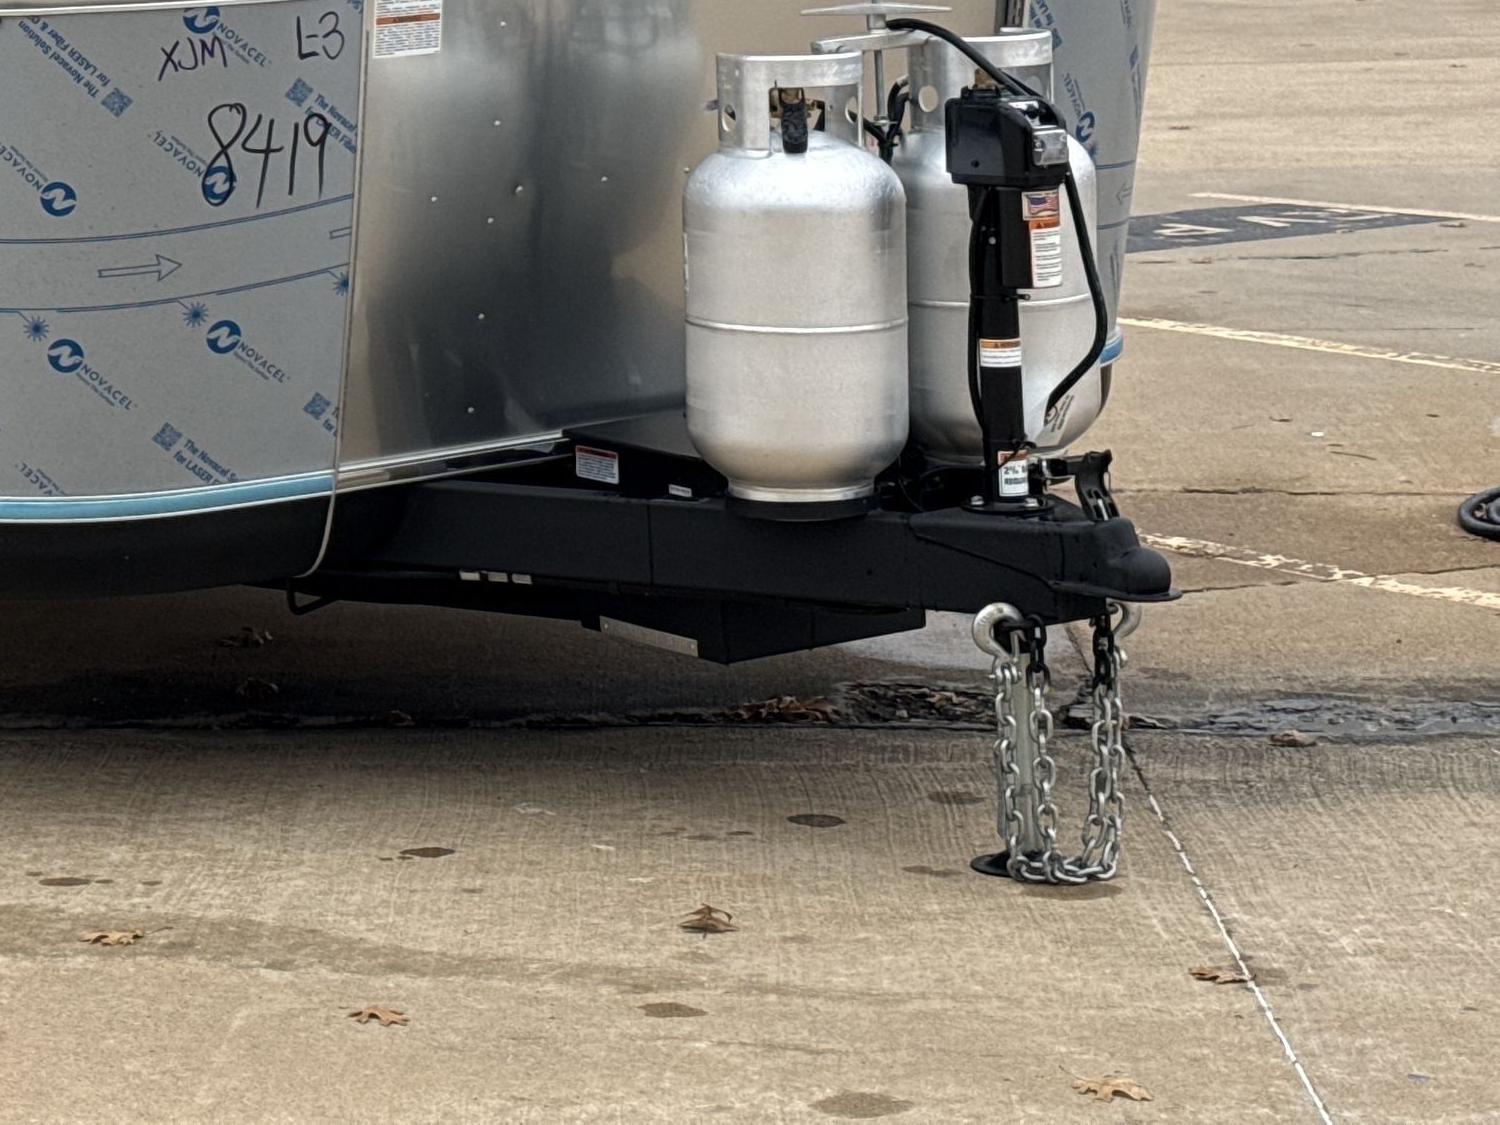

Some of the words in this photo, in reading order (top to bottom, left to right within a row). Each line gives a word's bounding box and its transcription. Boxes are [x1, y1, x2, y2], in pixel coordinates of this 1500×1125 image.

[18, 20, 51, 54] Solution
[47, 29, 70, 51] Fiber
[217, 22, 266, 67] NOVACEL
[49, 51, 83, 83] Novacel
[67, 47, 97, 75] LASER
[82, 80, 99, 98] The
[96, 72, 110, 86] for
[314, 93, 328, 110] The
[327, 105, 357, 132] Novacel
[152, 131, 205, 177] NOVACEL
[201, 102, 332, 208] 8419
[238, 342, 286, 383] NOVACEL
[80, 364, 133, 410] NOVACEL
[173, 450, 187, 464] for
[185, 459, 213, 483] LASER
[183, 438, 199, 455] The
[197, 450, 230, 476] Novacel
[19, 463, 52, 495] VACEL
